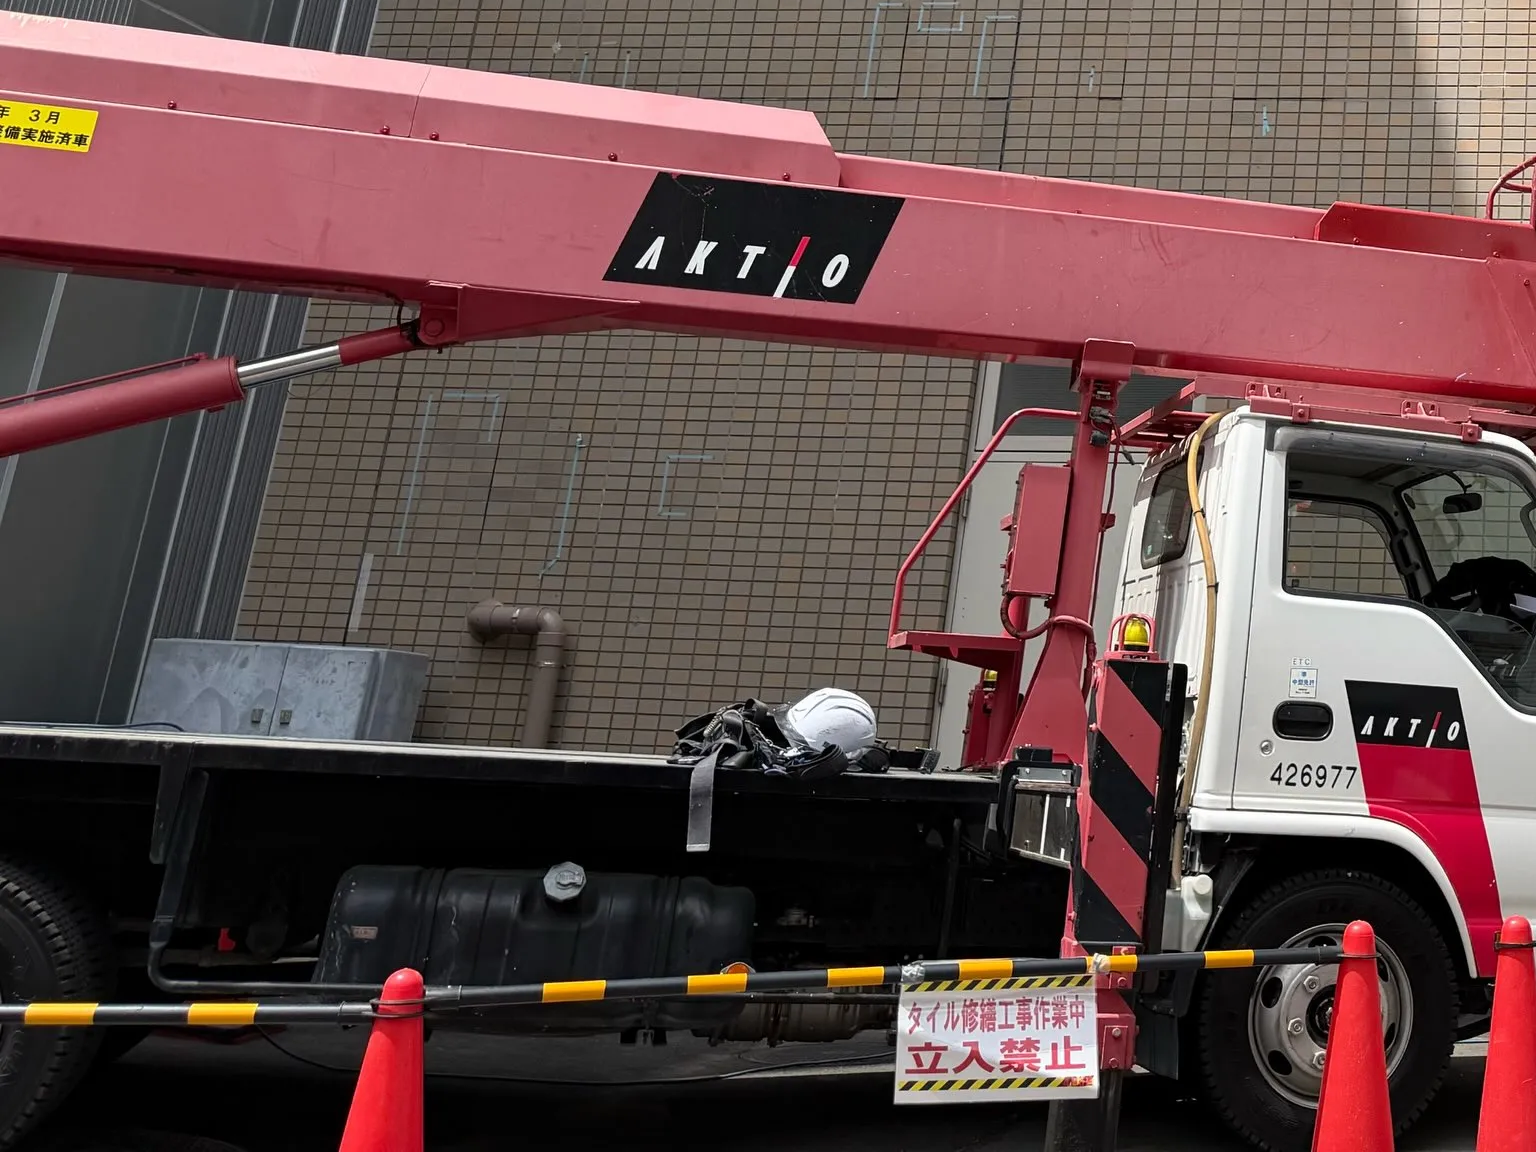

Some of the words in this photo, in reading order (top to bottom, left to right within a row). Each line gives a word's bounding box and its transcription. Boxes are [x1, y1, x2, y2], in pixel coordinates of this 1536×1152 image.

[634, 235, 850, 298] AKTIO
[1292, 658, 1311, 666] ETC
[1361, 711, 1460, 748] AKTIO
[1270, 762, 1357, 789] 426977
[908, 995, 1085, 1035] タイル修繕工事作業中
[905, 1035, 1086, 1074] 立入禁止
